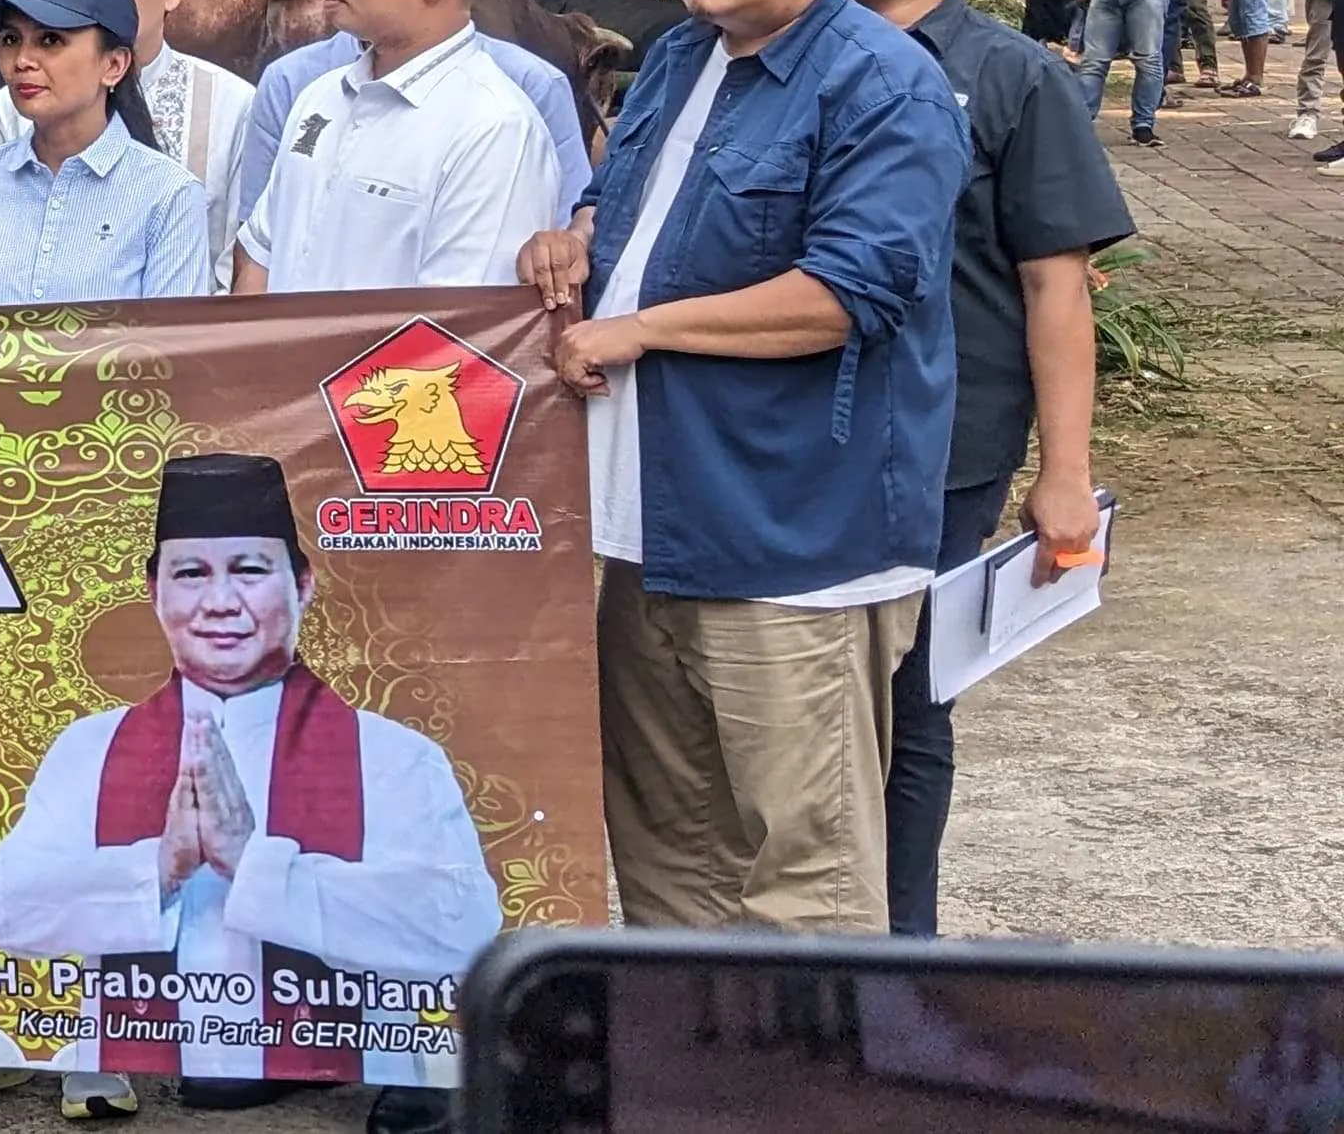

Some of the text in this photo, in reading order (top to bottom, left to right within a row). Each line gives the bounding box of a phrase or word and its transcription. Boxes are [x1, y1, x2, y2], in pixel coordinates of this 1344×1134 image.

[317, 499, 542, 535] GERINDRA
[320, 536, 540, 549] GERAKAN INDONESIA RAYA
[51, 960, 255, 1004] Prabowo
[271, 967, 457, 1012] Subiant
[17, 1008, 456, 1054] Ketua Umum Partai GERINDRA
